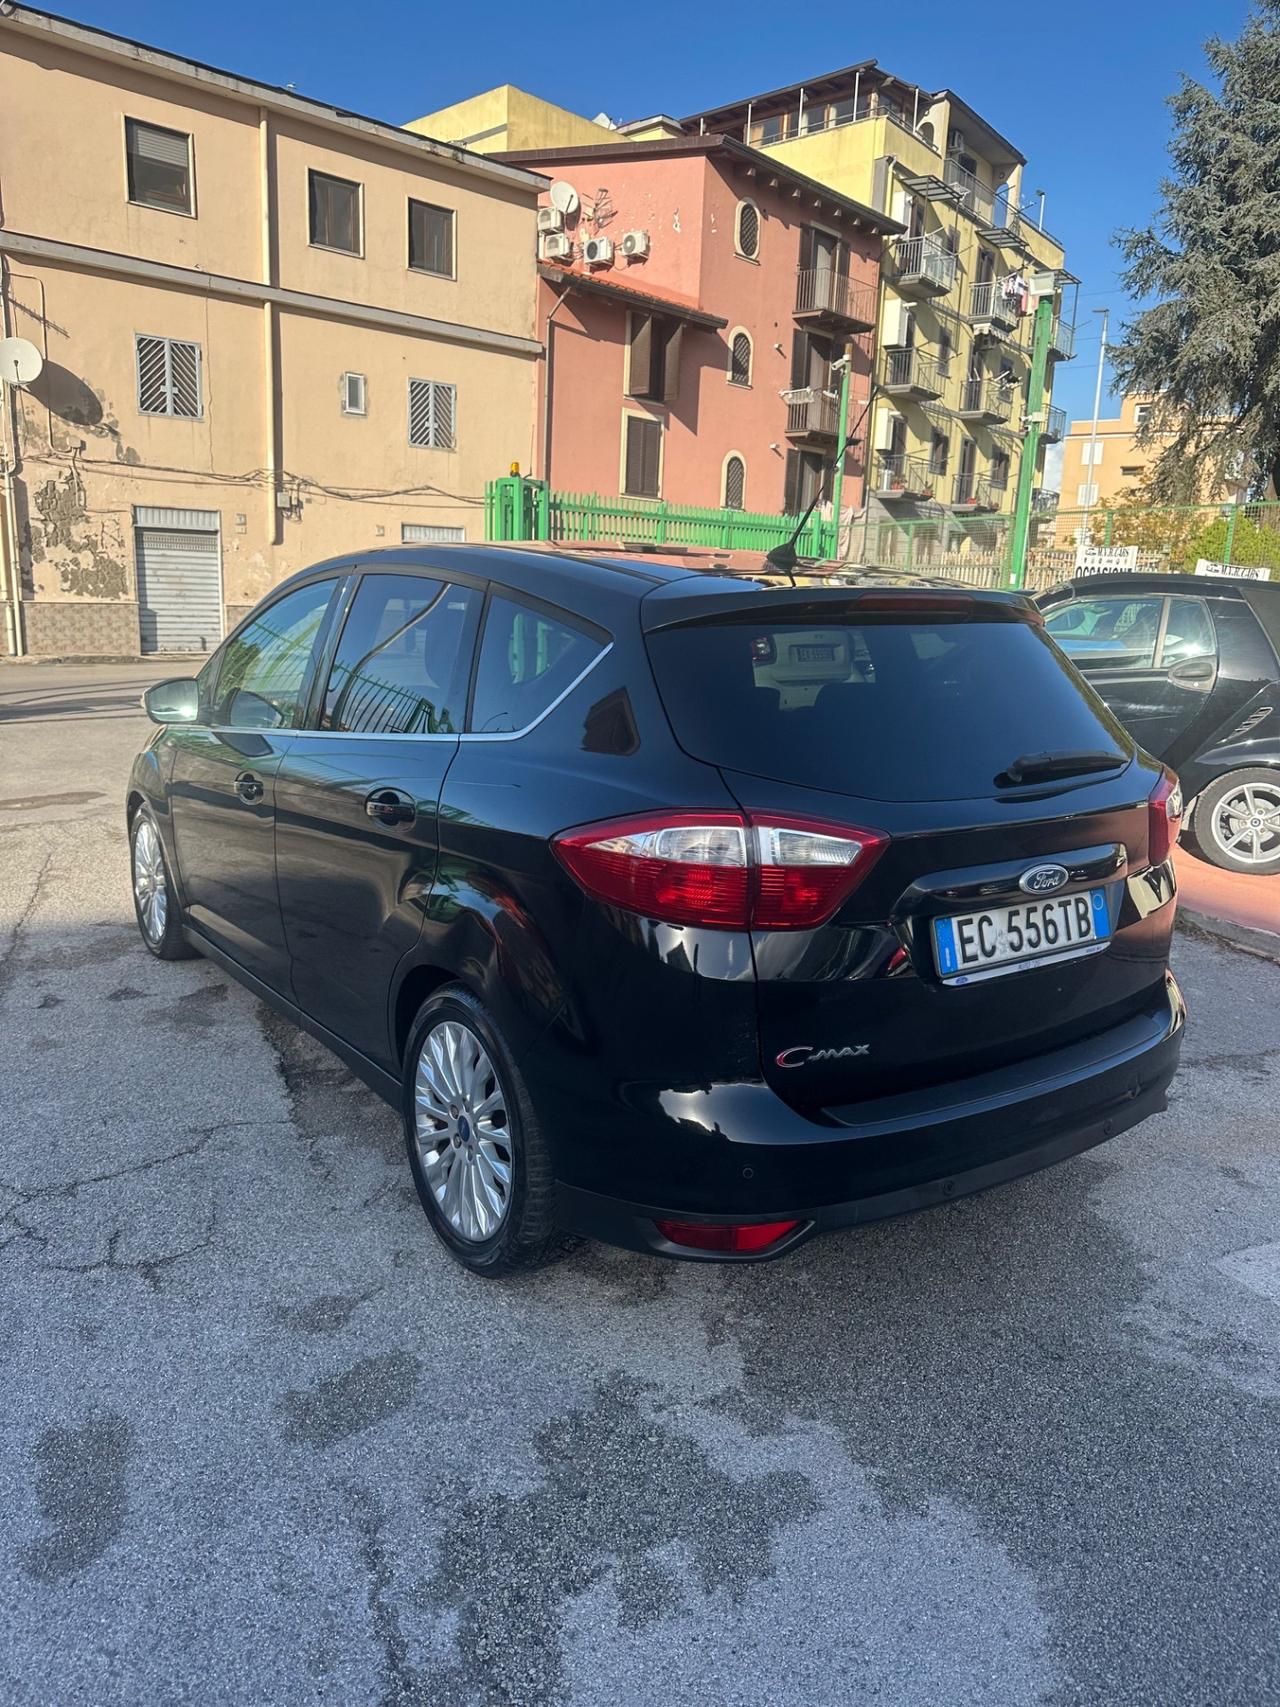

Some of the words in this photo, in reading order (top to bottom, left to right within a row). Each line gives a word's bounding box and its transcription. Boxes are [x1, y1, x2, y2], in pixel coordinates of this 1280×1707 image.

[1034, 871, 1060, 889] Ford
[957, 914, 996, 964] EC
[1007, 896, 1092, 953] 556TB
